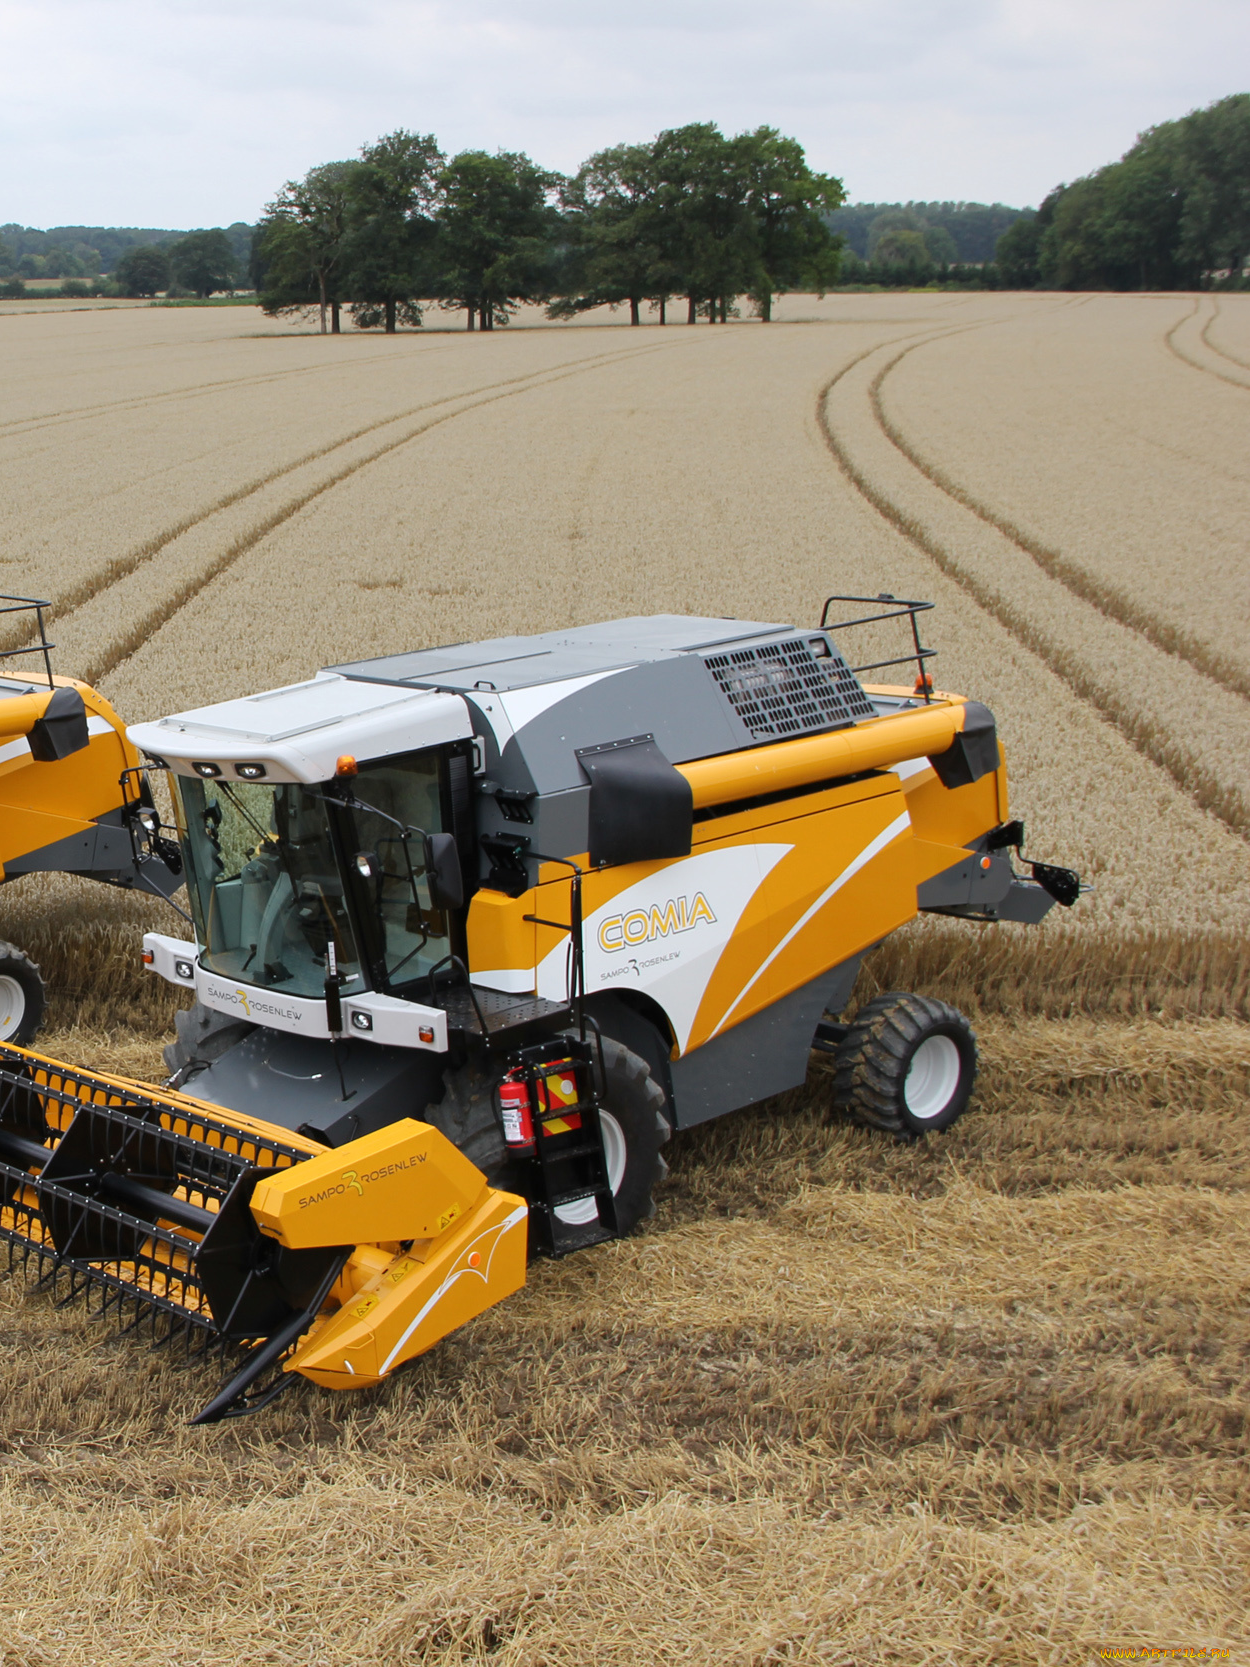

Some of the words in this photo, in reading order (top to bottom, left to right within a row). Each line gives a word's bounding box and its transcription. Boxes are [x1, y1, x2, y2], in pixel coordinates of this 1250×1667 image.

[597, 891, 717, 953] COMIA
[600, 967, 629, 981] SAMPO
[638, 951, 681, 968] ROSENLEW
[207, 987, 238, 1004] SAMPO
[248, 1000, 302, 1020] ROSENLEW
[298, 1184, 345, 1209] SAMPO
[360, 1152, 427, 1183] ROSENLEW
